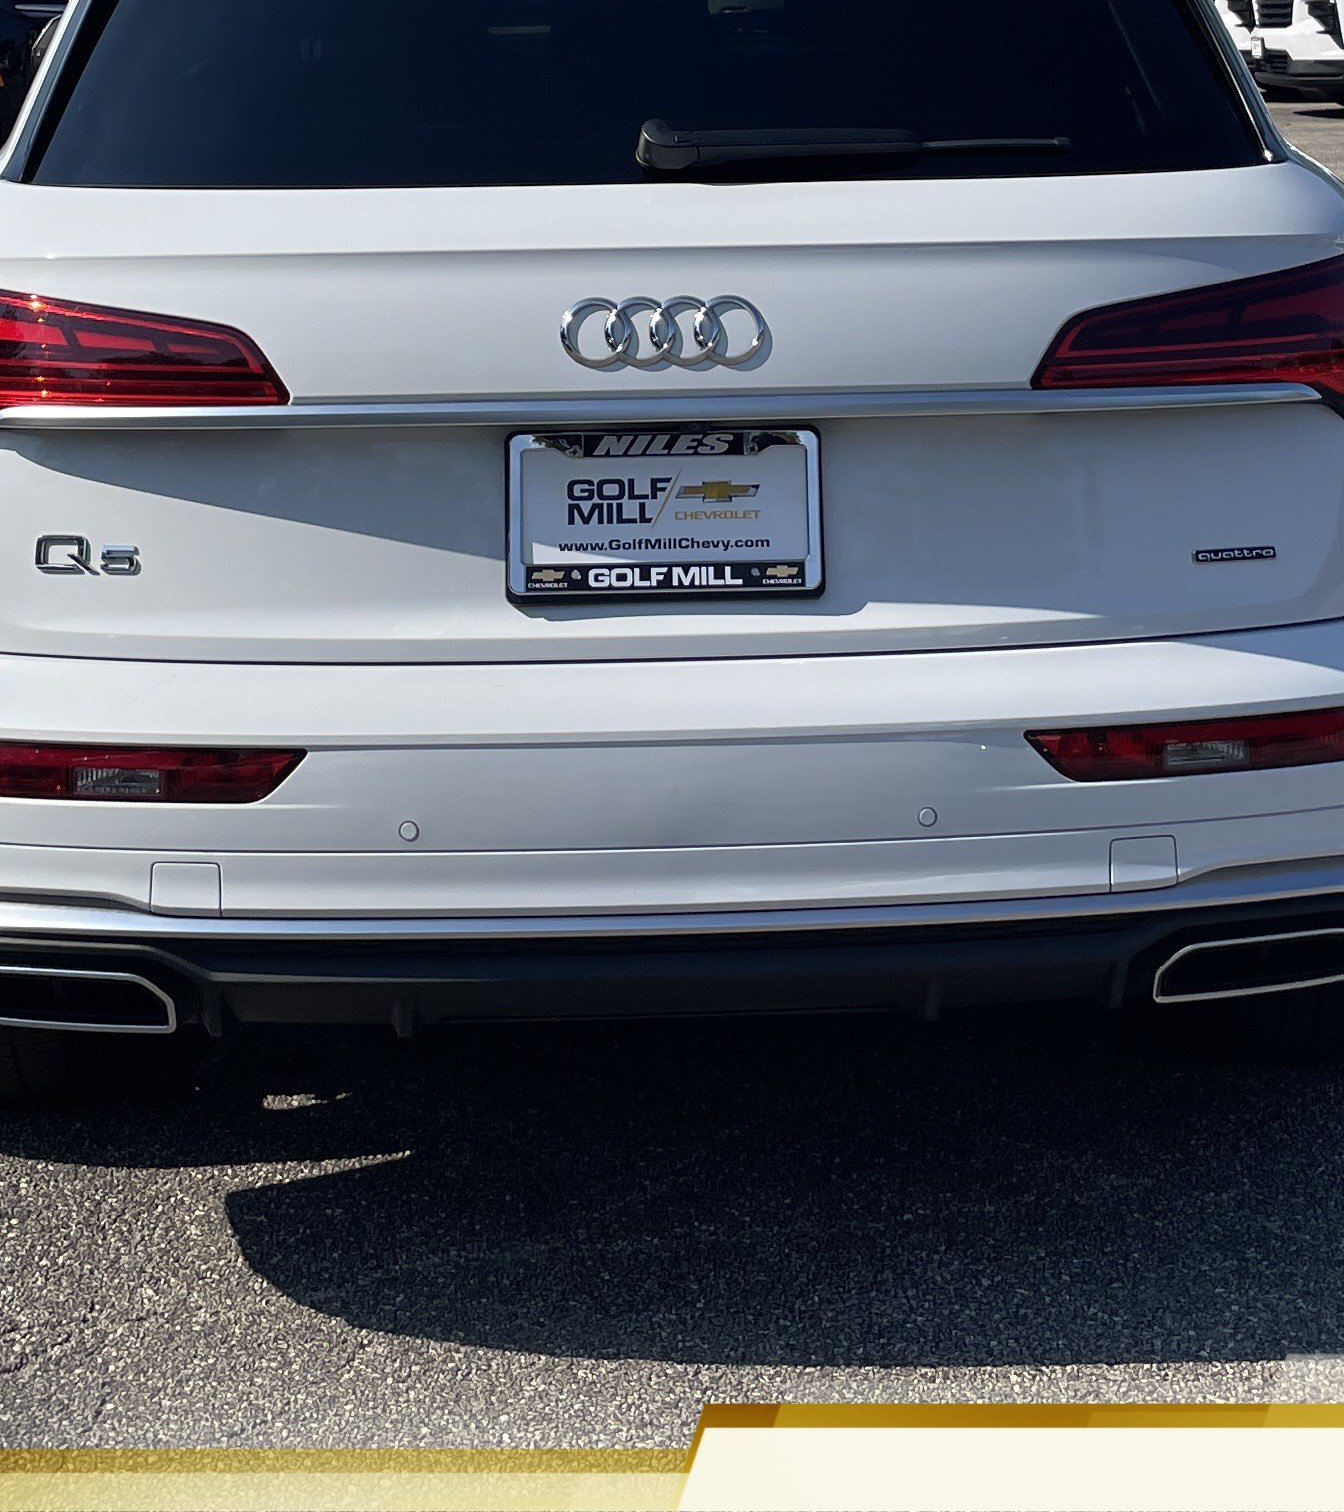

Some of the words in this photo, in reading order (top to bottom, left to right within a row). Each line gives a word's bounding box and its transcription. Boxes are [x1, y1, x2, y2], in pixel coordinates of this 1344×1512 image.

[593, 433, 734, 457] NILES
[566, 476, 674, 502] GOLF
[567, 501, 654, 526] MILL
[674, 509, 762, 521] CHEVROLET
[35, 534, 142, 576] Q5
[558, 537, 771, 552] www.GolfMillChevy.com
[1198, 548, 1274, 562] quattro
[588, 566, 669, 587] GOLF
[672, 565, 743, 587] MILL
